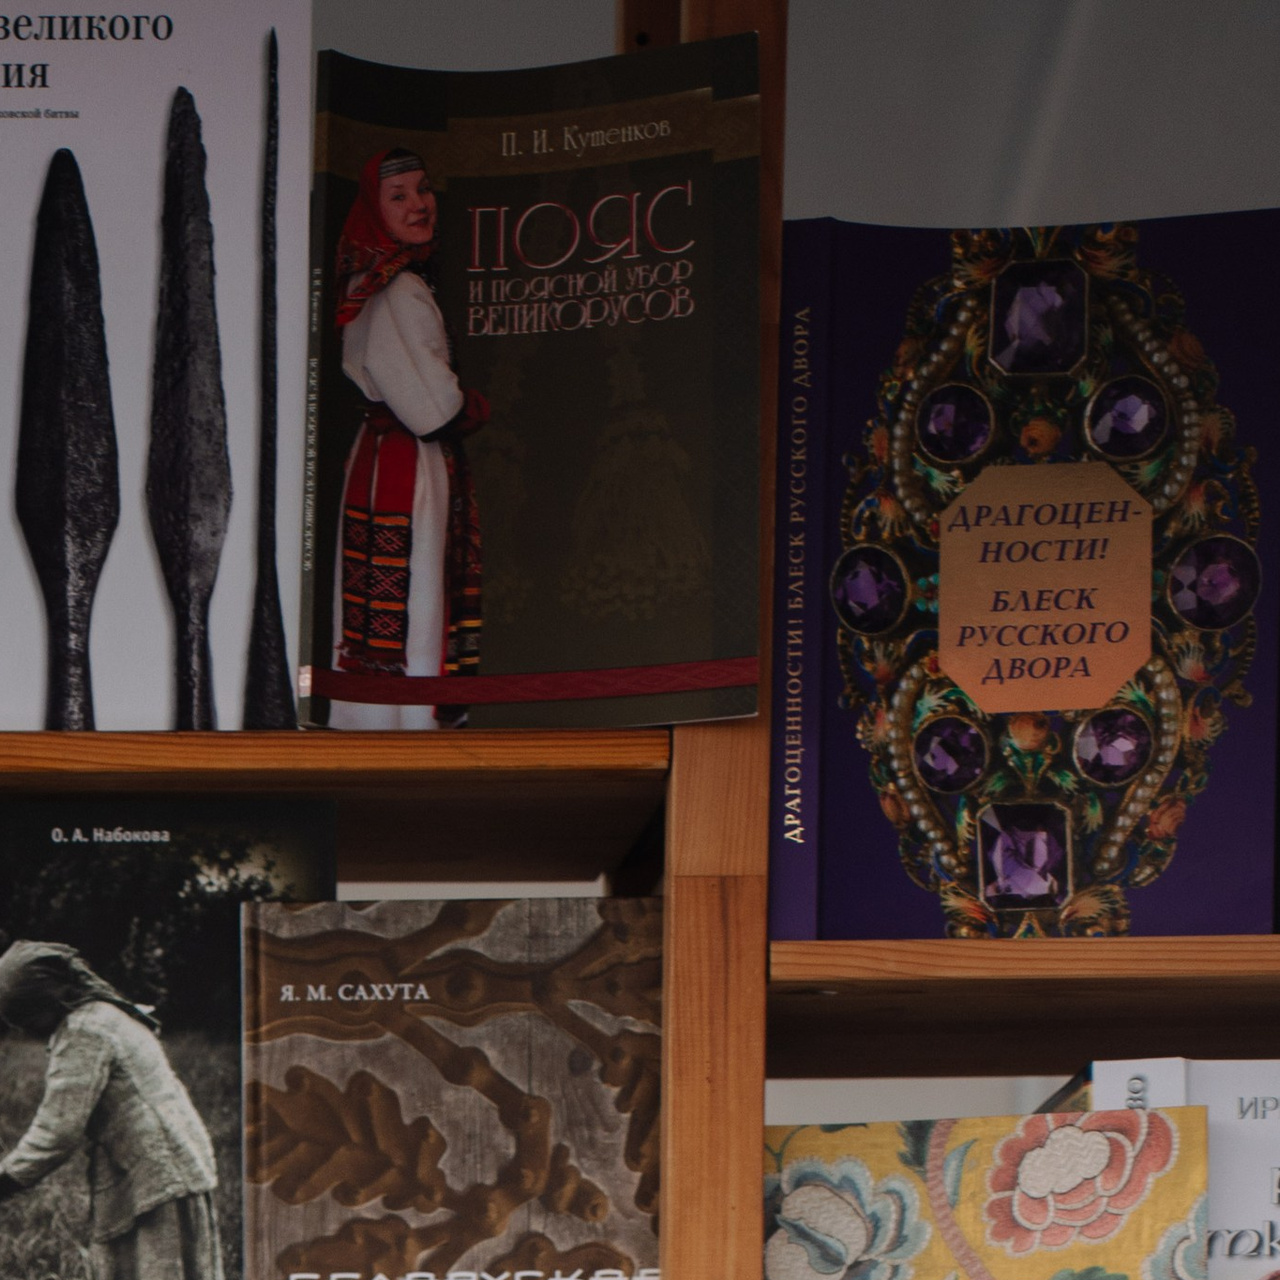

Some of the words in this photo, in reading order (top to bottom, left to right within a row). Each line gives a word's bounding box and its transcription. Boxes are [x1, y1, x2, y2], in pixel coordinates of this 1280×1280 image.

[43, 107, 80, 119] битвы
[501, 132, 523, 157] П.
[532, 129, 554, 153] И.
[563, 119, 671, 158] Кутенков
[466, 180, 696, 272] ПОЯС
[469, 281, 483, 303] И
[491, 264, 618, 303] ПОЯСНОЙ
[625, 259, 693, 292] УБОР
[468, 287, 695, 337] ВЕЛИКОРУСОВ
[791, 306, 812, 388] ДВОРА
[787, 396, 809, 527] РУССКОГО
[947, 502, 1143, 532] ДРАГОЦЕН-
[978, 538, 1108, 564] НОСТИ!
[786, 534, 807, 610] БЛЕСК
[989, 588, 1098, 613] БЛЕСК
[956, 621, 1130, 648] РУССКОГО
[981, 656, 1092, 684] ДВОРА
[782, 617, 807, 844] ДРАГОЦЕННОСТИ!
[51, 827, 69, 843] О.
[72, 827, 90, 843] А.
[92, 826, 170, 843] Набокова
[279, 985, 301, 1002] Я.
[306, 984, 332, 1002] М.
[337, 982, 431, 1002] САХУТА
